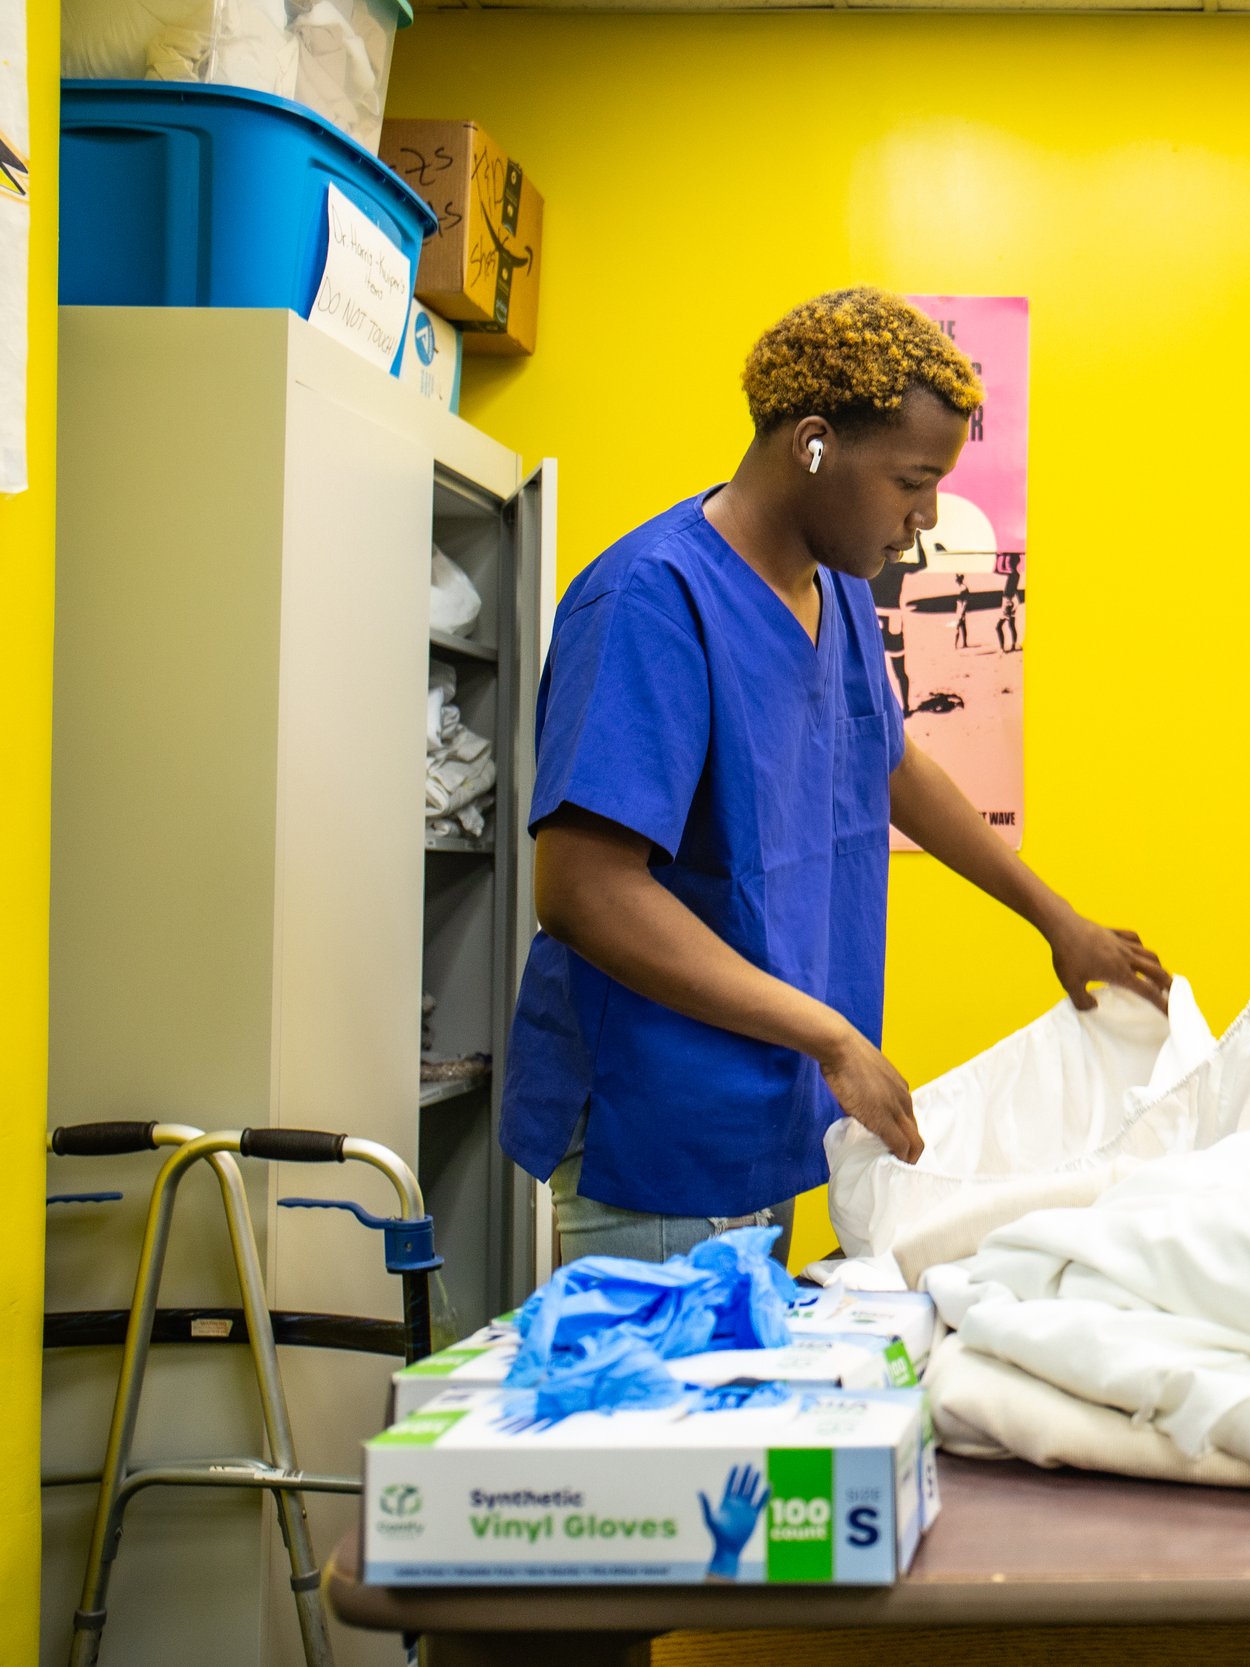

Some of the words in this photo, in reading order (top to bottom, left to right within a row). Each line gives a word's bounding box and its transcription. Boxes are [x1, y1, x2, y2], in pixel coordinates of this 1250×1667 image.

[317, 275, 341, 314] DO
[342, 297, 367, 331] NOT
[989, 812, 1015, 826] WAVE
[470, 1488, 584, 1512] Synthetic
[846, 1487, 881, 1501] SIZE
[769, 1498, 831, 1526] 100
[469, 1512, 553, 1544] Vinyl
[562, 1514, 678, 1540] Gloves
[770, 1524, 827, 1542] count
[846, 1506, 880, 1548] S
